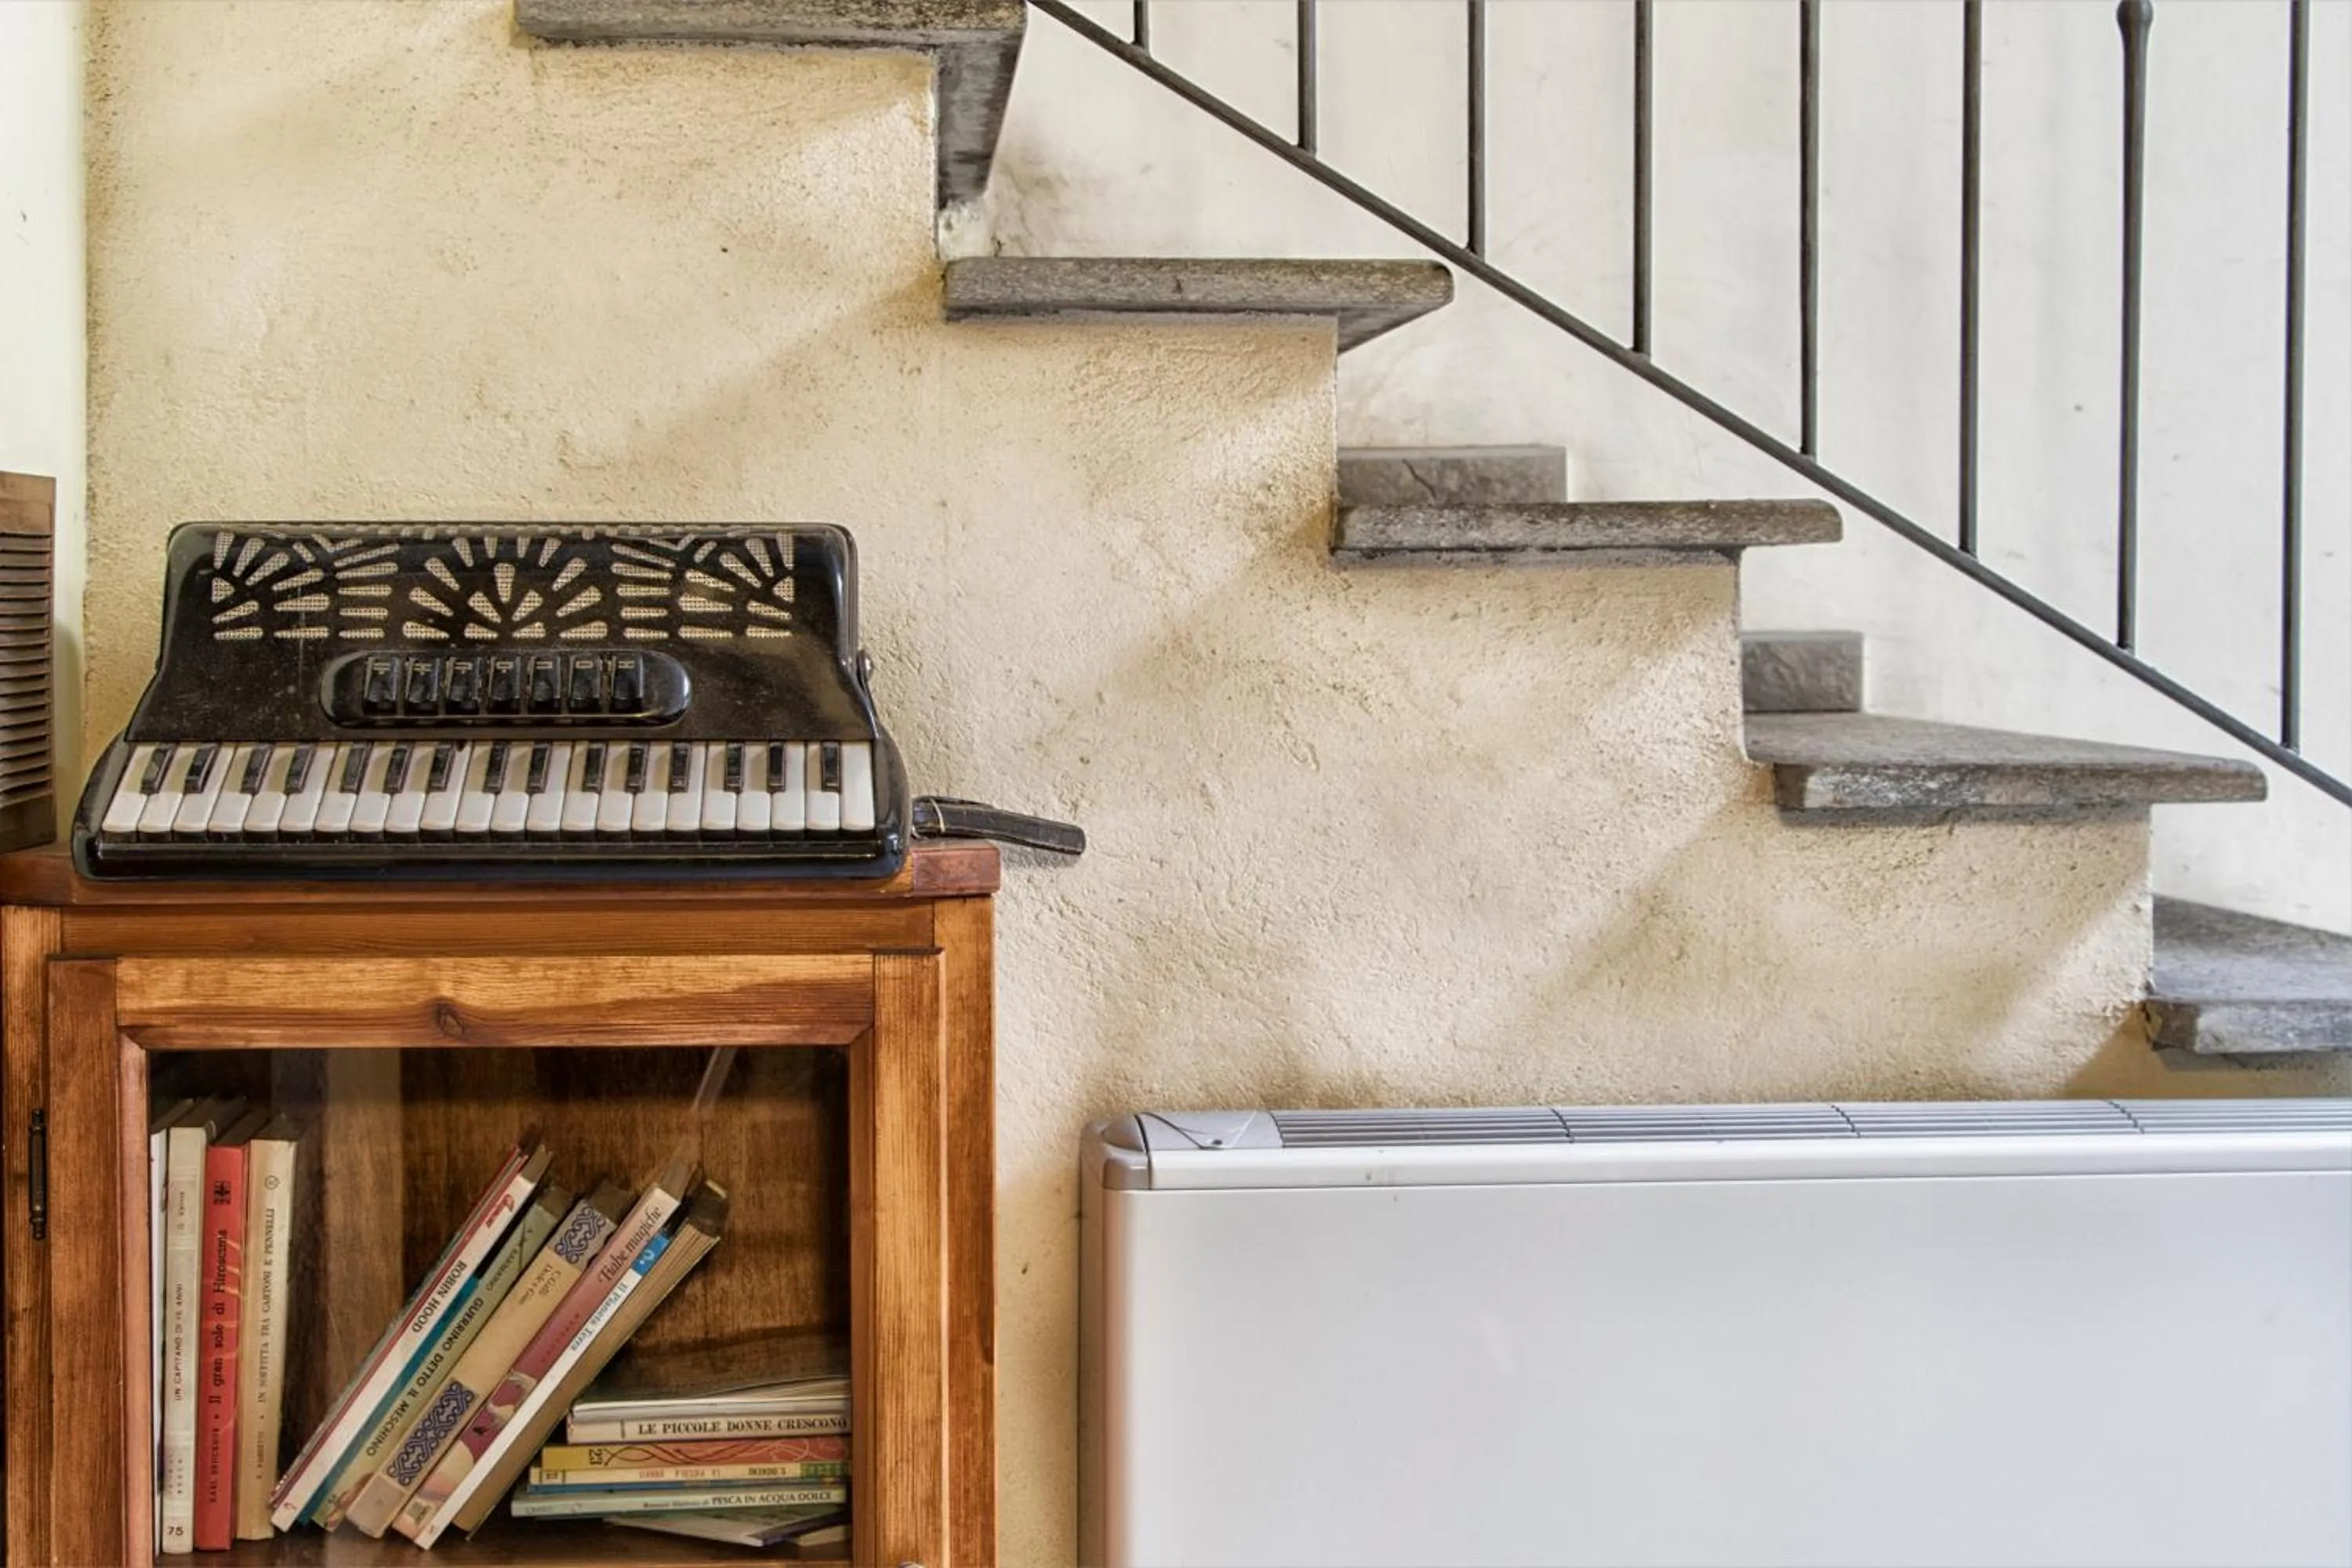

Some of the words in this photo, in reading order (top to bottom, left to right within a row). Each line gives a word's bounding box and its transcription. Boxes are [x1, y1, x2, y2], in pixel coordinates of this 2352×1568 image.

[264, 1207, 274, 1254] PENNELLI
[595, 1247, 630, 1286] Fiabe
[624, 1204, 664, 1252] magiche
[213, 1229, 227, 1293] Hiroscima
[262, 1271, 272, 1313] CARTONI
[436, 1260, 467, 1298] ROBIN
[212, 1302, 225, 1315] di
[411, 1298, 440, 1333] HOOD
[589, 1290, 621, 1327] Pianeta
[211, 1323, 223, 1348] sole
[439, 1295, 485, 1353] GUERRINO
[569, 1327, 593, 1353] Terra
[174, 1337, 183, 1384] CAPITANO
[213, 1358, 225, 1387] gran
[414, 1351, 445, 1388] DETTO
[173, 1388, 181, 1400] UN
[208, 1395, 221, 1403] Il
[257, 1392, 268, 1403] IN
[405, 1387, 419, 1400] IL
[364, 1399, 411, 1458] MESCHINO
[638, 1421, 657, 1436] LE
[662, 1420, 720, 1435] PICCOLE
[727, 1418, 772, 1432] DONNE
[777, 1417, 847, 1431] CRESCONO
[588, 1449, 602, 1466] 23
[712, 1494, 742, 1506] PESCA
[744, 1494, 757, 1504] IN
[759, 1493, 796, 1505] ACQUA
[798, 1491, 831, 1502] DOLCE
[167, 1525, 183, 1536] 75
